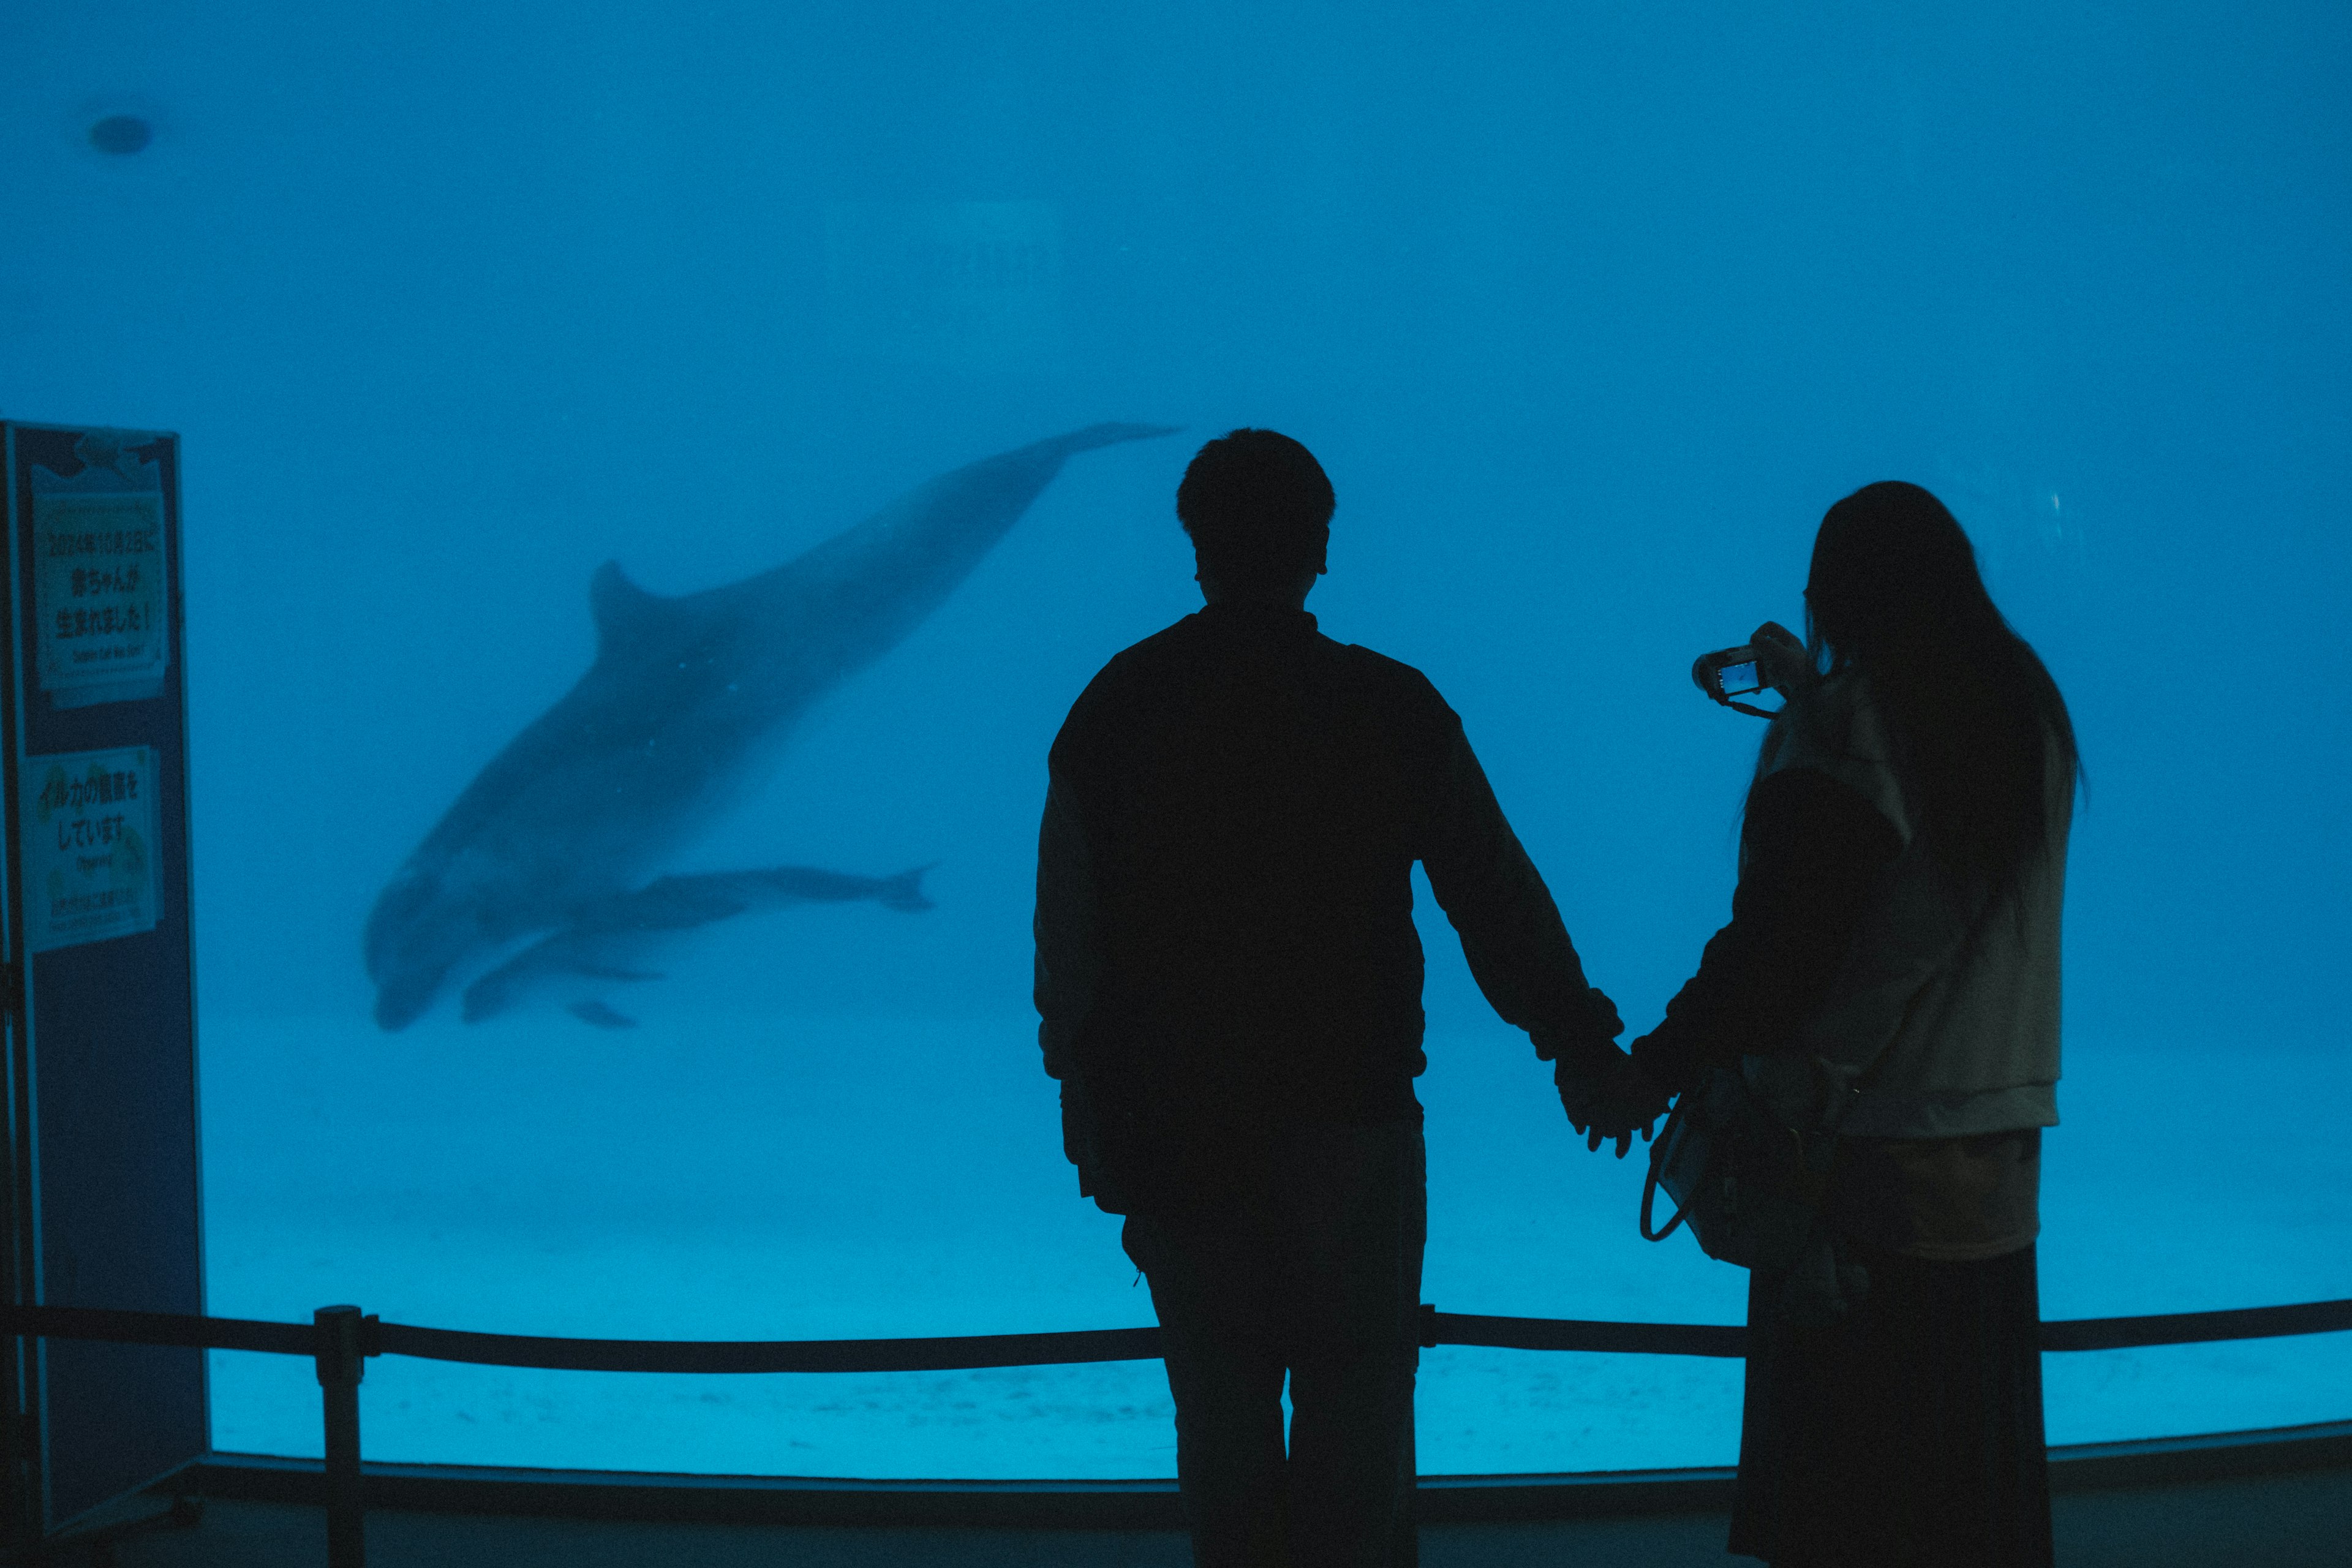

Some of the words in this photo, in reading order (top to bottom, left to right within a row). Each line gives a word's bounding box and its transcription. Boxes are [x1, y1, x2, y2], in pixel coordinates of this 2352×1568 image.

[49, 530, 154, 556] 2024年10月2日に
[72, 564, 140, 598] 赤ちゃんが
